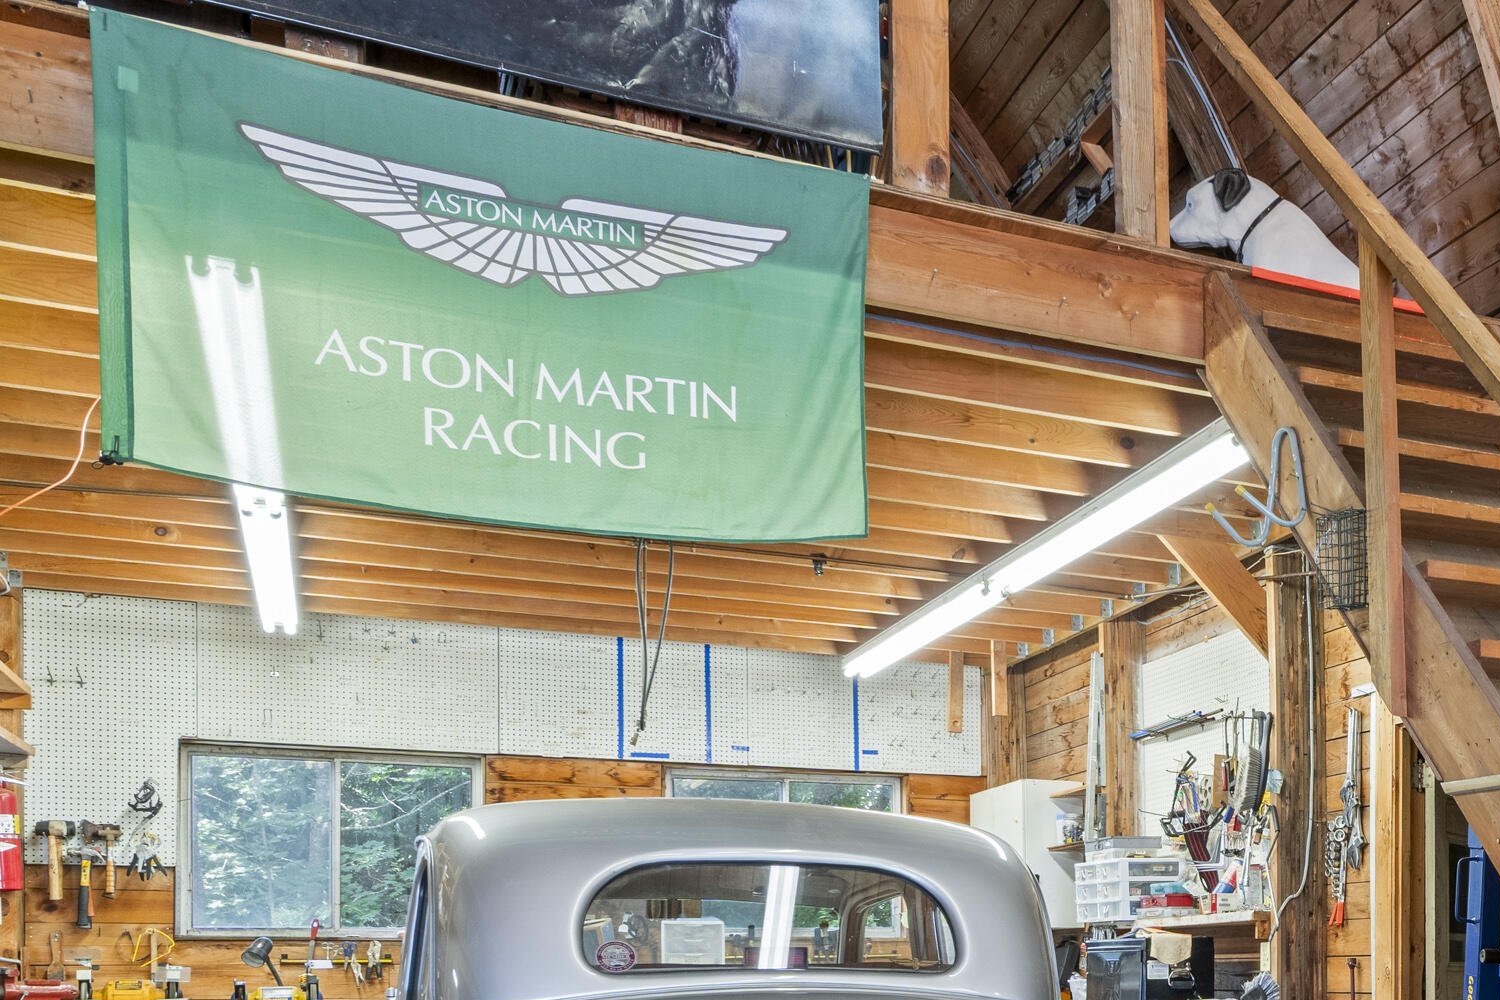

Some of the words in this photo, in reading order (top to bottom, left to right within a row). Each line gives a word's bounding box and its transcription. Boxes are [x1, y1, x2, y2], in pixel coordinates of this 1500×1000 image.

[425, 190, 521, 226] ASTON
[532, 210, 635, 245] MARTIN
[314, 329, 514, 397] ASTON
[535, 362, 737, 423] MARTIN
[423, 407, 647, 469] RACING
